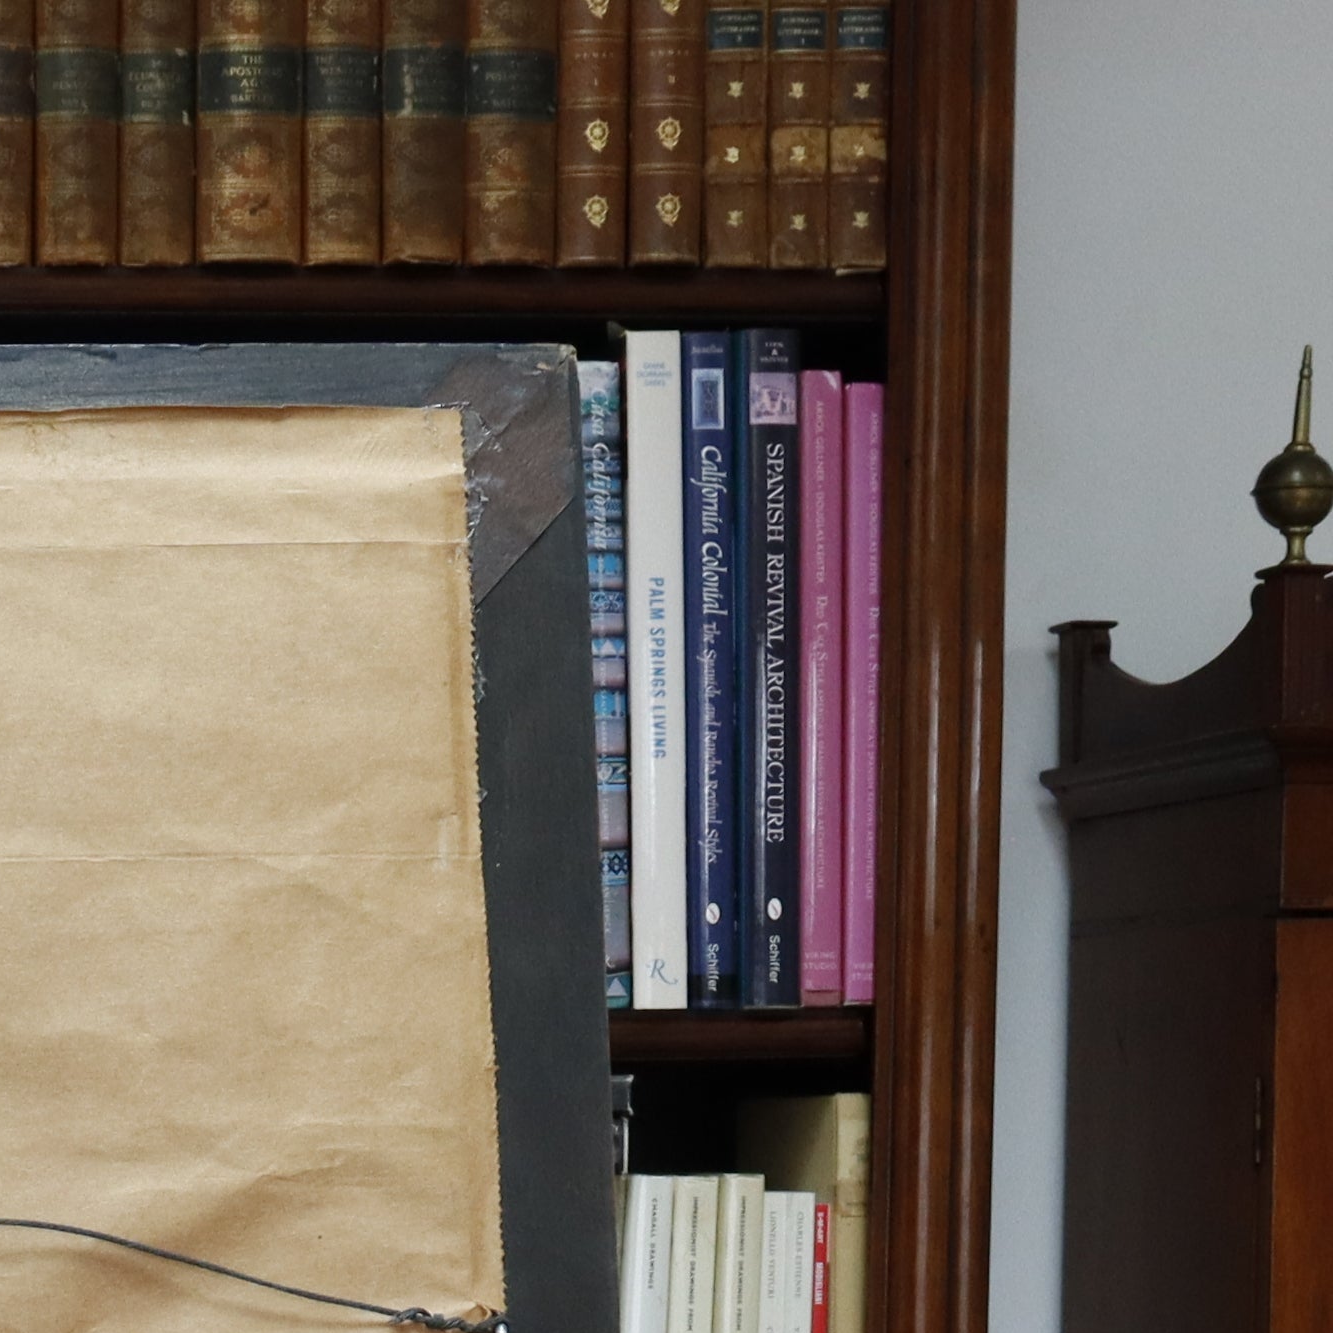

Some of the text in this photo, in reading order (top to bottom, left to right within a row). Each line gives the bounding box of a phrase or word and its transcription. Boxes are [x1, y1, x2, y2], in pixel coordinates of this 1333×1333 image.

[584, 387, 613, 550] Casa California
[690, 445, 728, 535] California
[701, 540, 729, 616] Colonial
[649, 577, 667, 760] PALM SPRINGS LIVING
[765, 442, 785, 843] SPANISH REVIVAL ARCHITECTURE
[696, 649, 721, 698] Spanish
[704, 701, 722, 728] and
[708, 944, 720, 993] Schiffer
[768, 935, 781, 984] Schiffer
[690, 1195, 699, 1257] IMPRESSIONIST
[737, 1195, 747, 1257] IMPRESSIONIST
[688, 1260, 696, 1305] DRAWINGS
[736, 1260, 745, 1305] DRAWINGS
[735, 1308, 743, 1331] FROM
